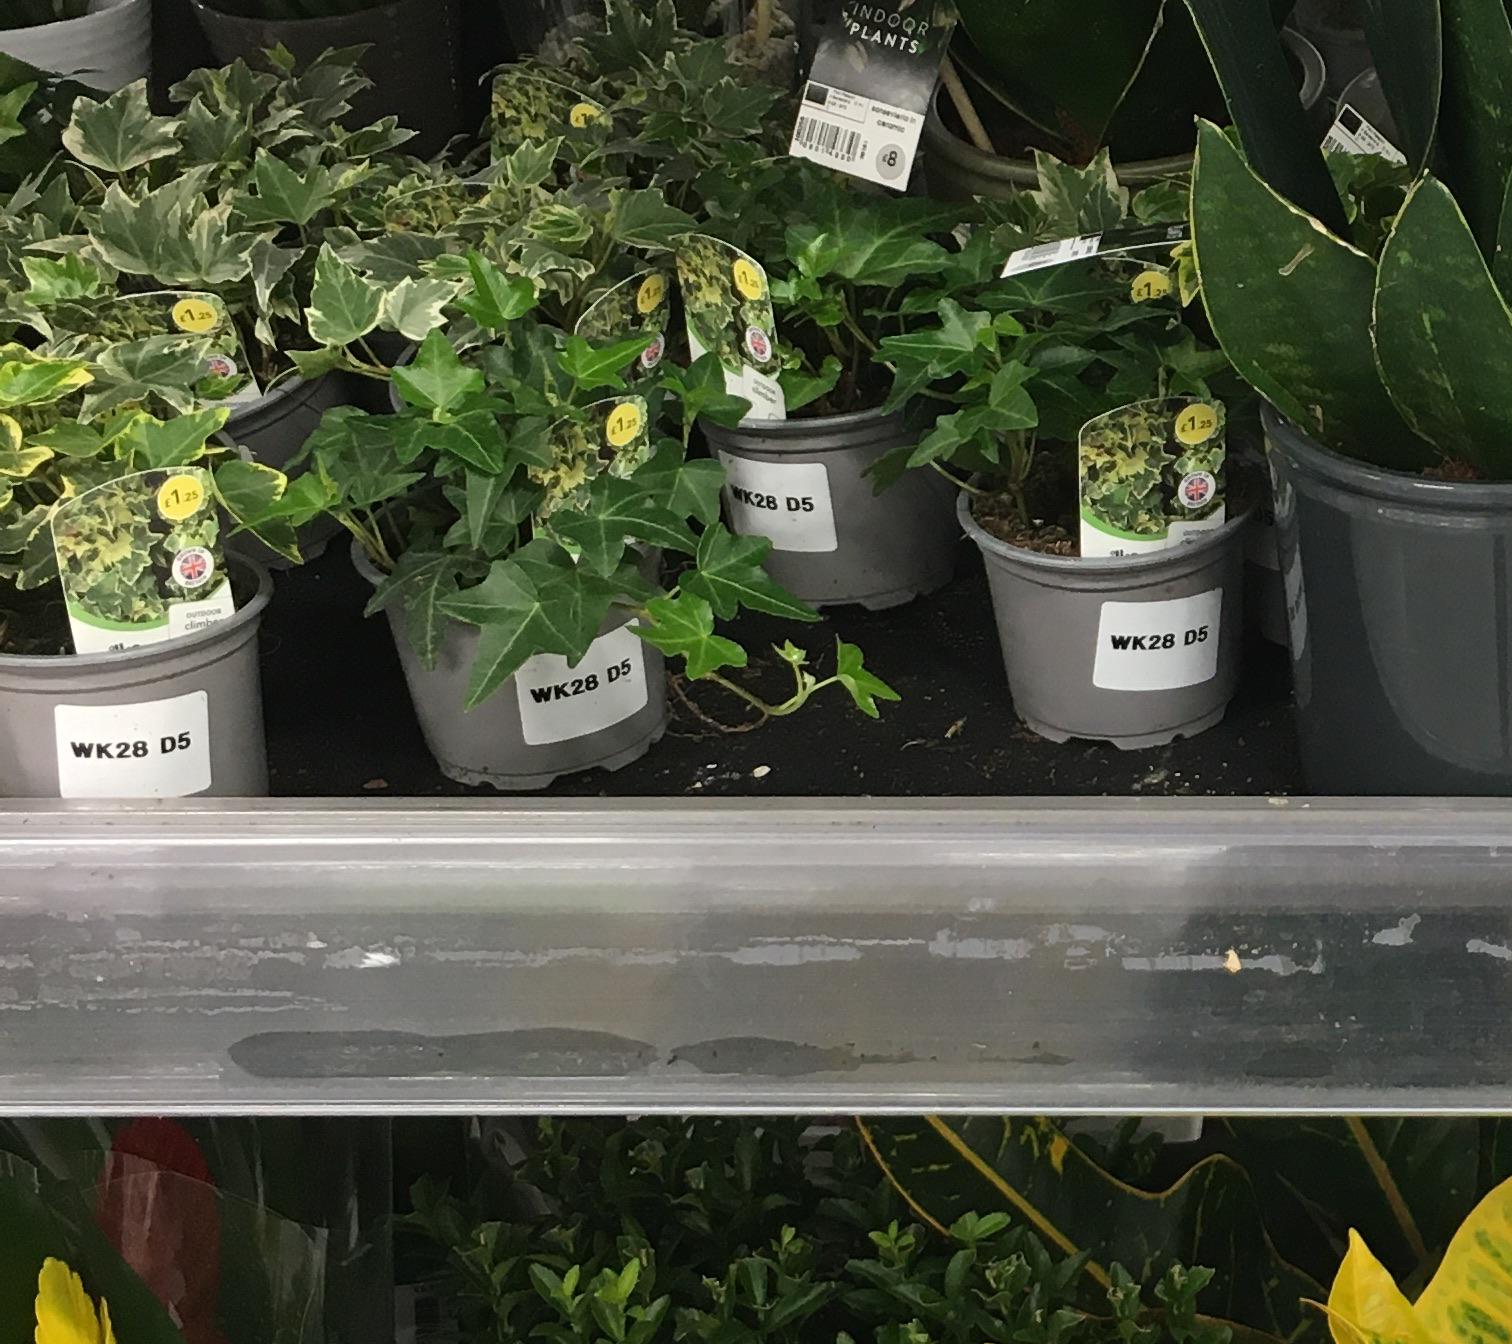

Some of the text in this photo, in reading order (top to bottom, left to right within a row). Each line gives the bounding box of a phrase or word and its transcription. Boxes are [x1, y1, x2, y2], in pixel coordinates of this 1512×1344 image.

[852, 2, 930, 36] INDOOR
[849, 22, 921, 55] PLANTS
[882, 150, 899, 167] £8
[611, 417, 638, 436] £1.25
[1181, 415, 1213, 433] £1.25
[164, 488, 199, 509] £1.25
[785, 496, 815, 512] D5
[185, 607, 223, 619] OUTDOOR
[1110, 625, 1209, 651] WK28 D5
[529, 658, 632, 704] WK28 D5
[70, 731, 192, 759] WK28 D5
